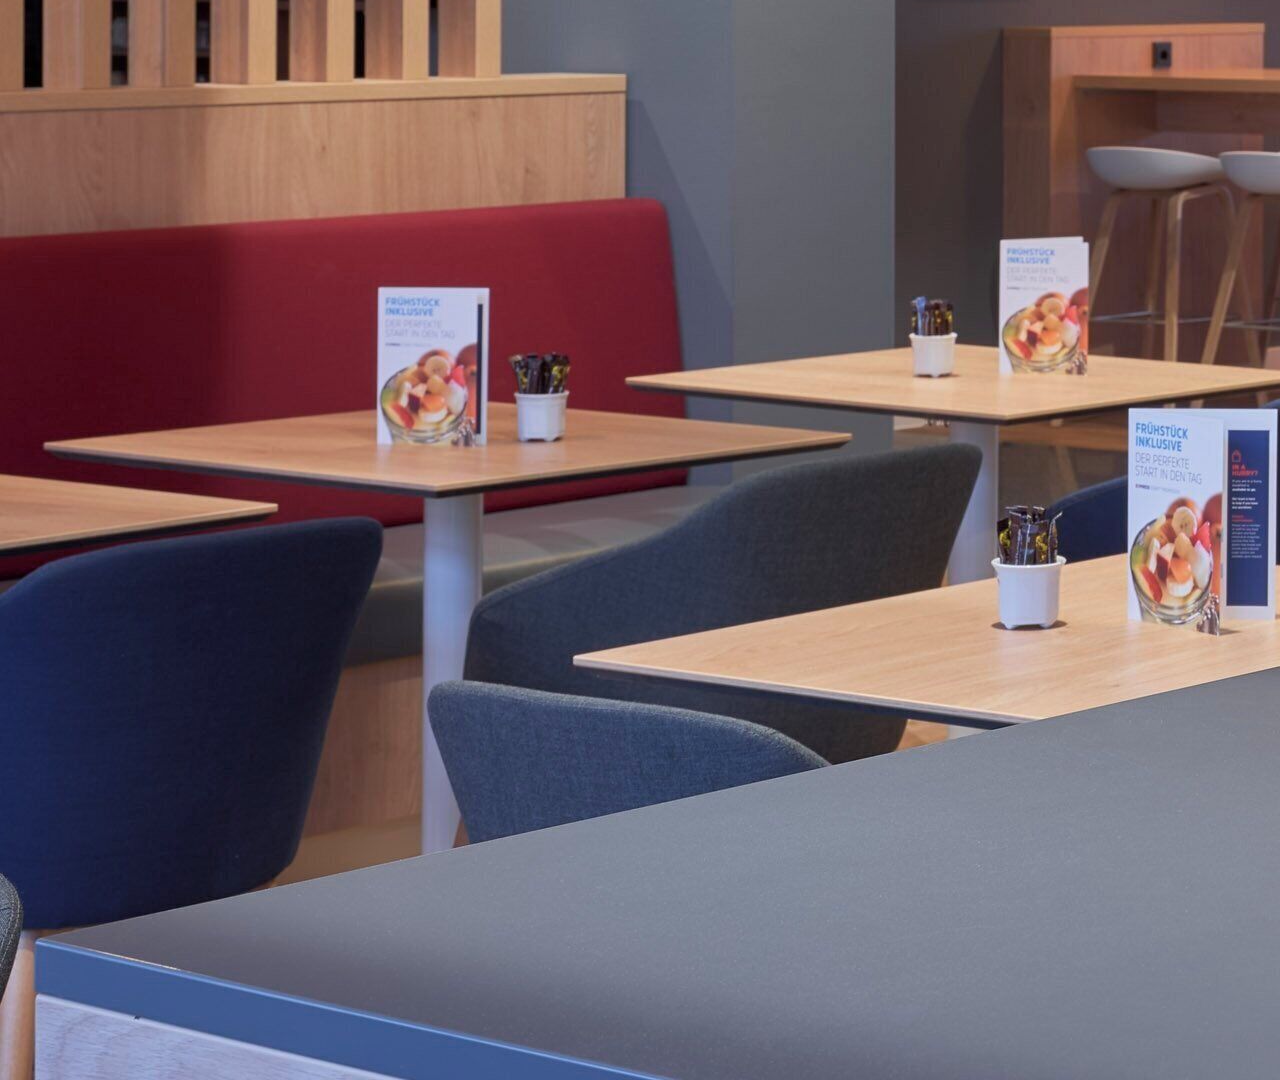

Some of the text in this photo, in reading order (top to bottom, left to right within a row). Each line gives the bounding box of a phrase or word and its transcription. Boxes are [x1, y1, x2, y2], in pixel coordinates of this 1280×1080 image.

[386, 297, 439, 307] FRÜHSTÜCK
[386, 308, 433, 316] INKLUSIVE
[1135, 422, 1188, 440] FRÜHSTÜCK
[1135, 436, 1182, 452] INKLUSIVE
[1135, 452, 1190, 470] DER PERFEKTE
[1135, 465, 1203, 486] START IN DEN TAG
